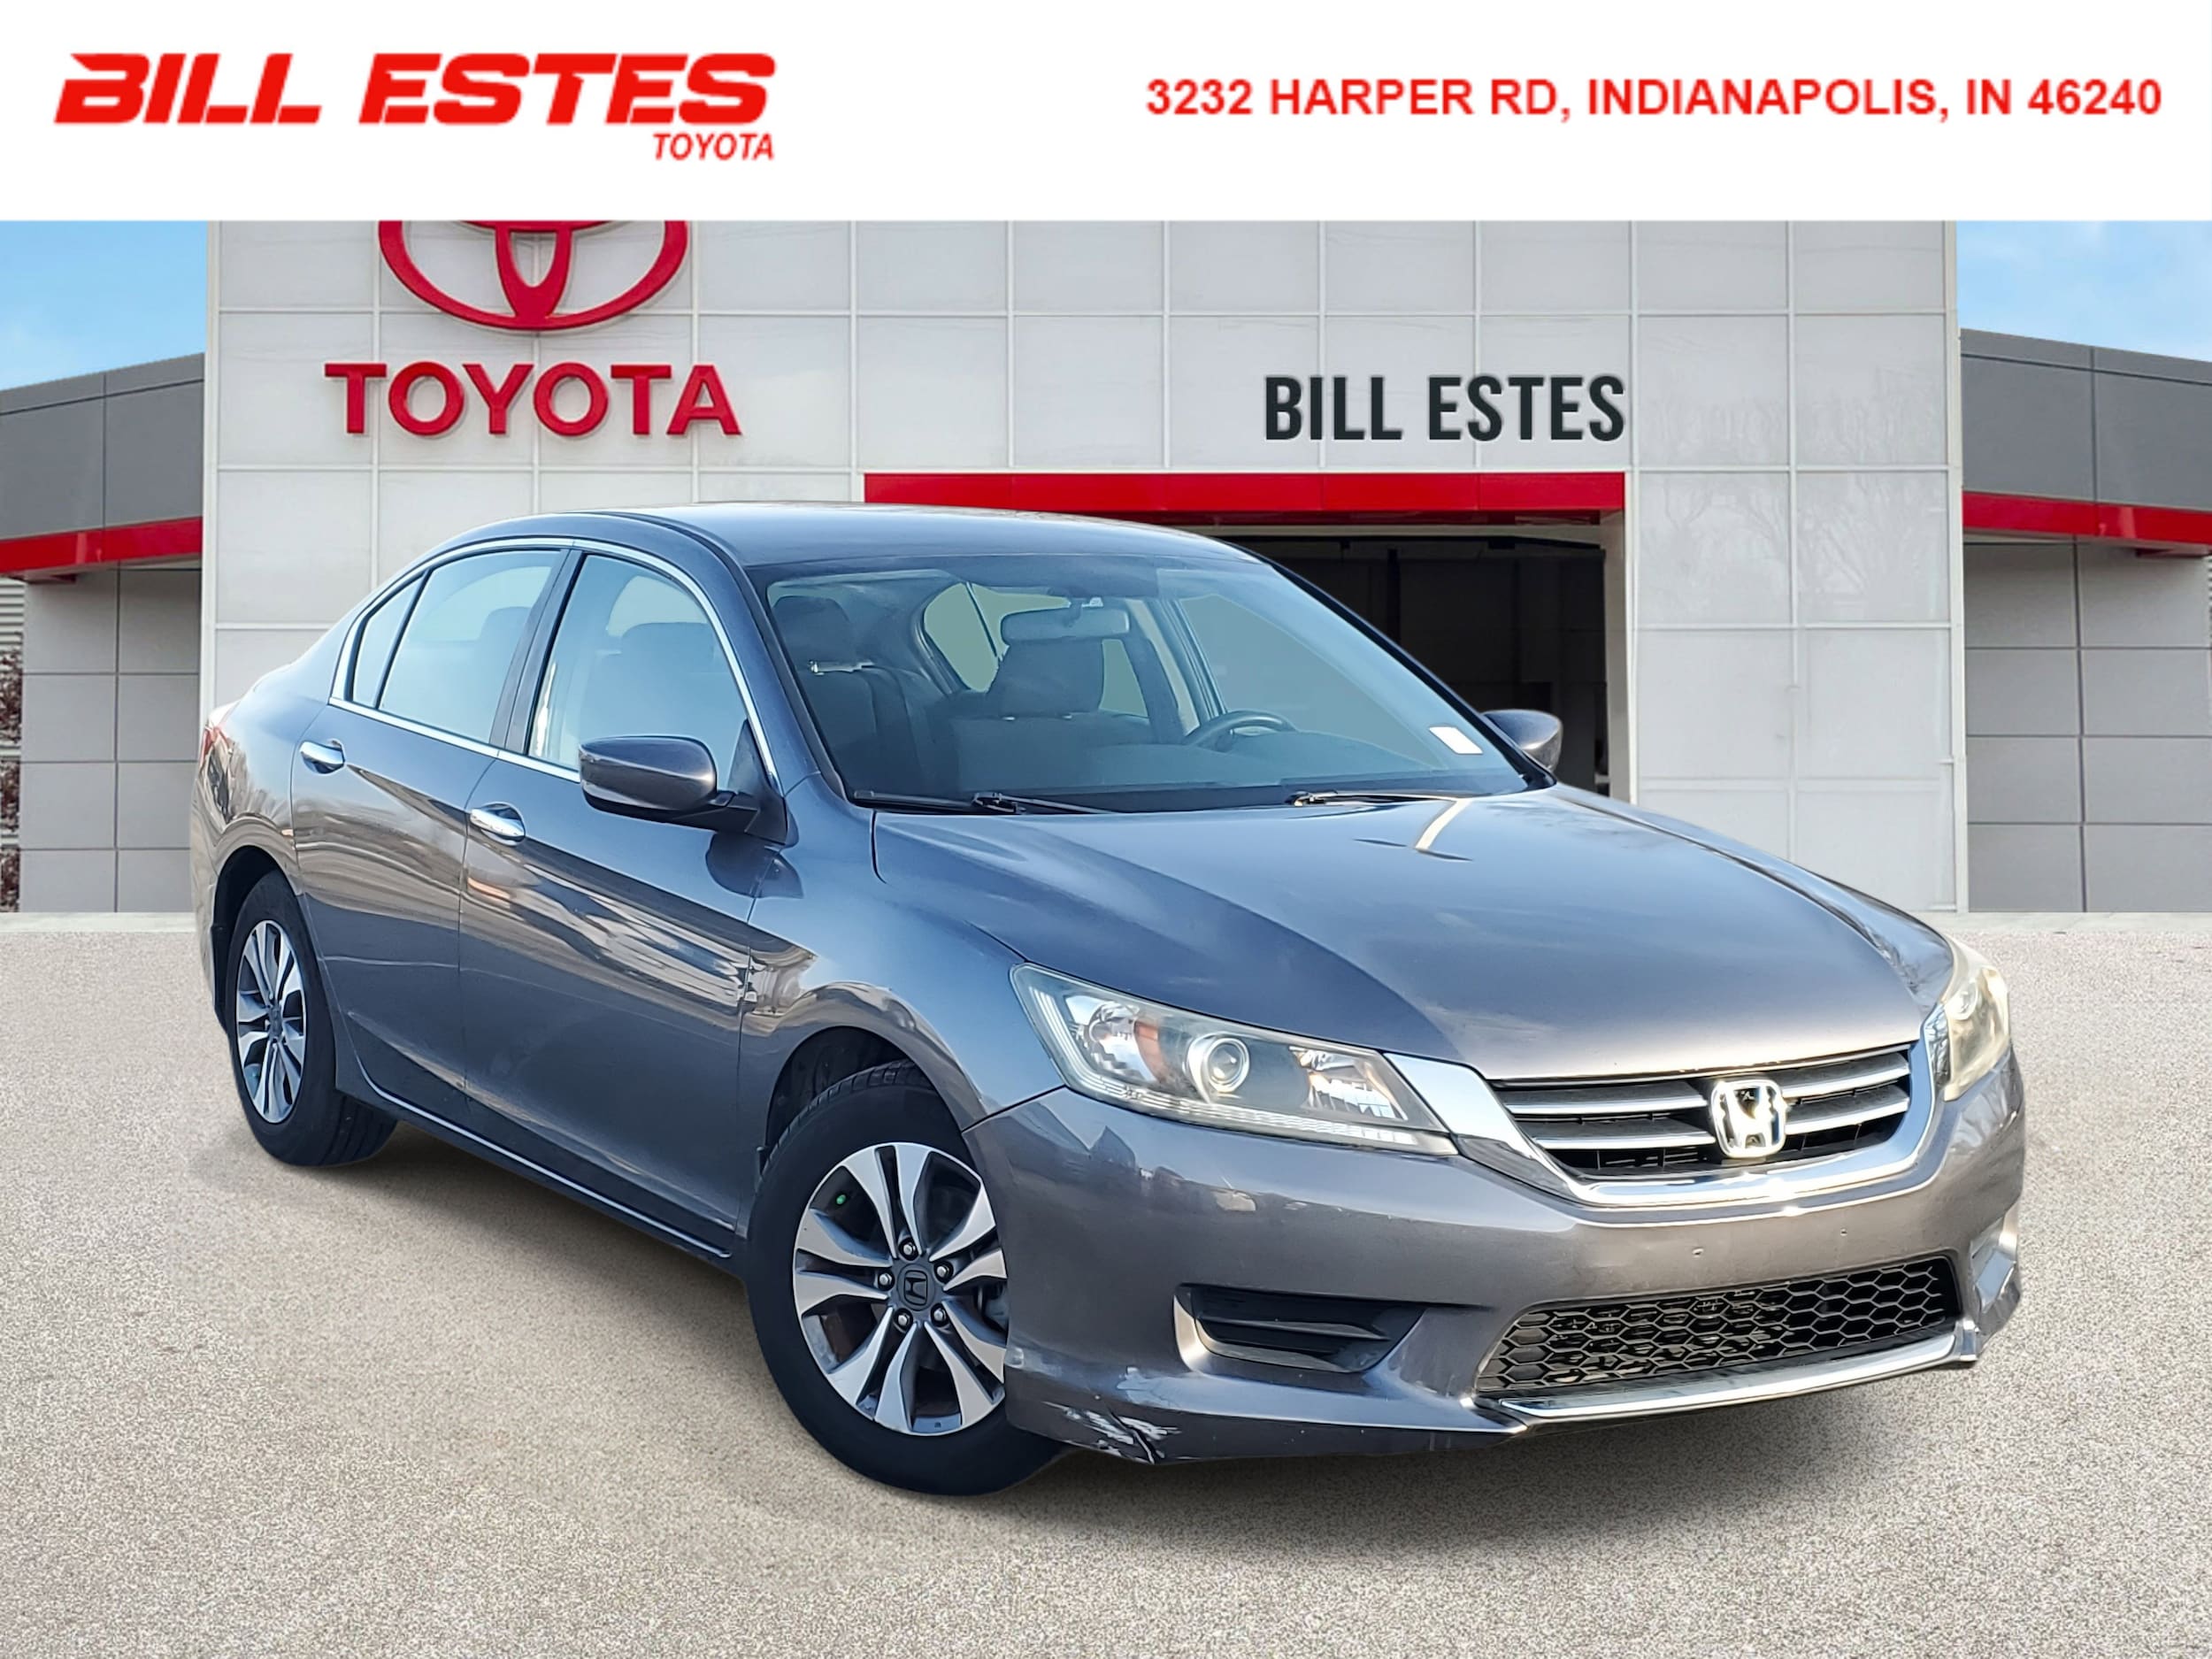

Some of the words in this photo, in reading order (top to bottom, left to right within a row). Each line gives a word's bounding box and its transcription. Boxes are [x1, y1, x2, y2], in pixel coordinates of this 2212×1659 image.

[325, 361, 741, 437] TOYOTA
[1265, 376, 1402, 441] BILL
[1429, 375, 1624, 442] ESTES
